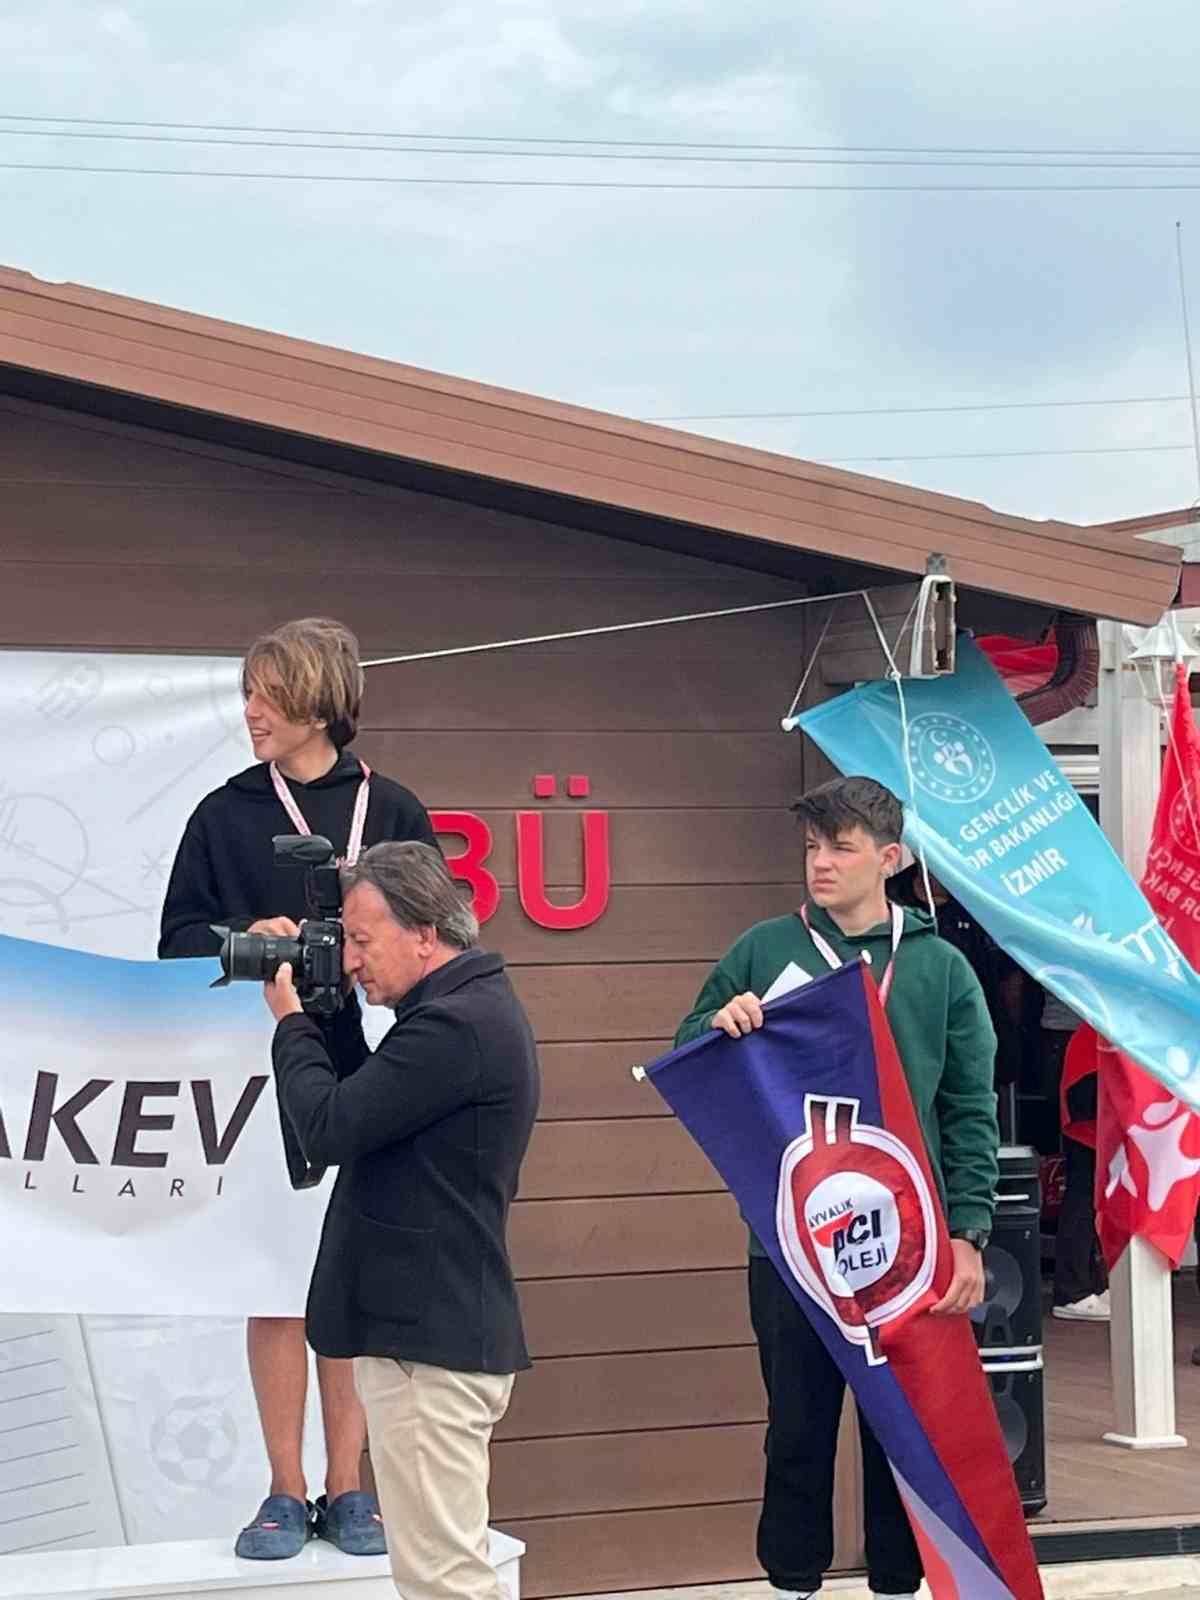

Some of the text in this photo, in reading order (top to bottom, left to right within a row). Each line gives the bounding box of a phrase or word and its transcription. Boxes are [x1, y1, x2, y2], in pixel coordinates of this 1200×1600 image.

[959, 769, 1059, 842] GENÇLİK VE
[989, 791, 1077, 857] BAKANLIĞI
[427, 774, 609, 930] BÜ
[1000, 848, 1068, 896] İZMİR
[837, 1242, 888, 1277] OLEJİ
